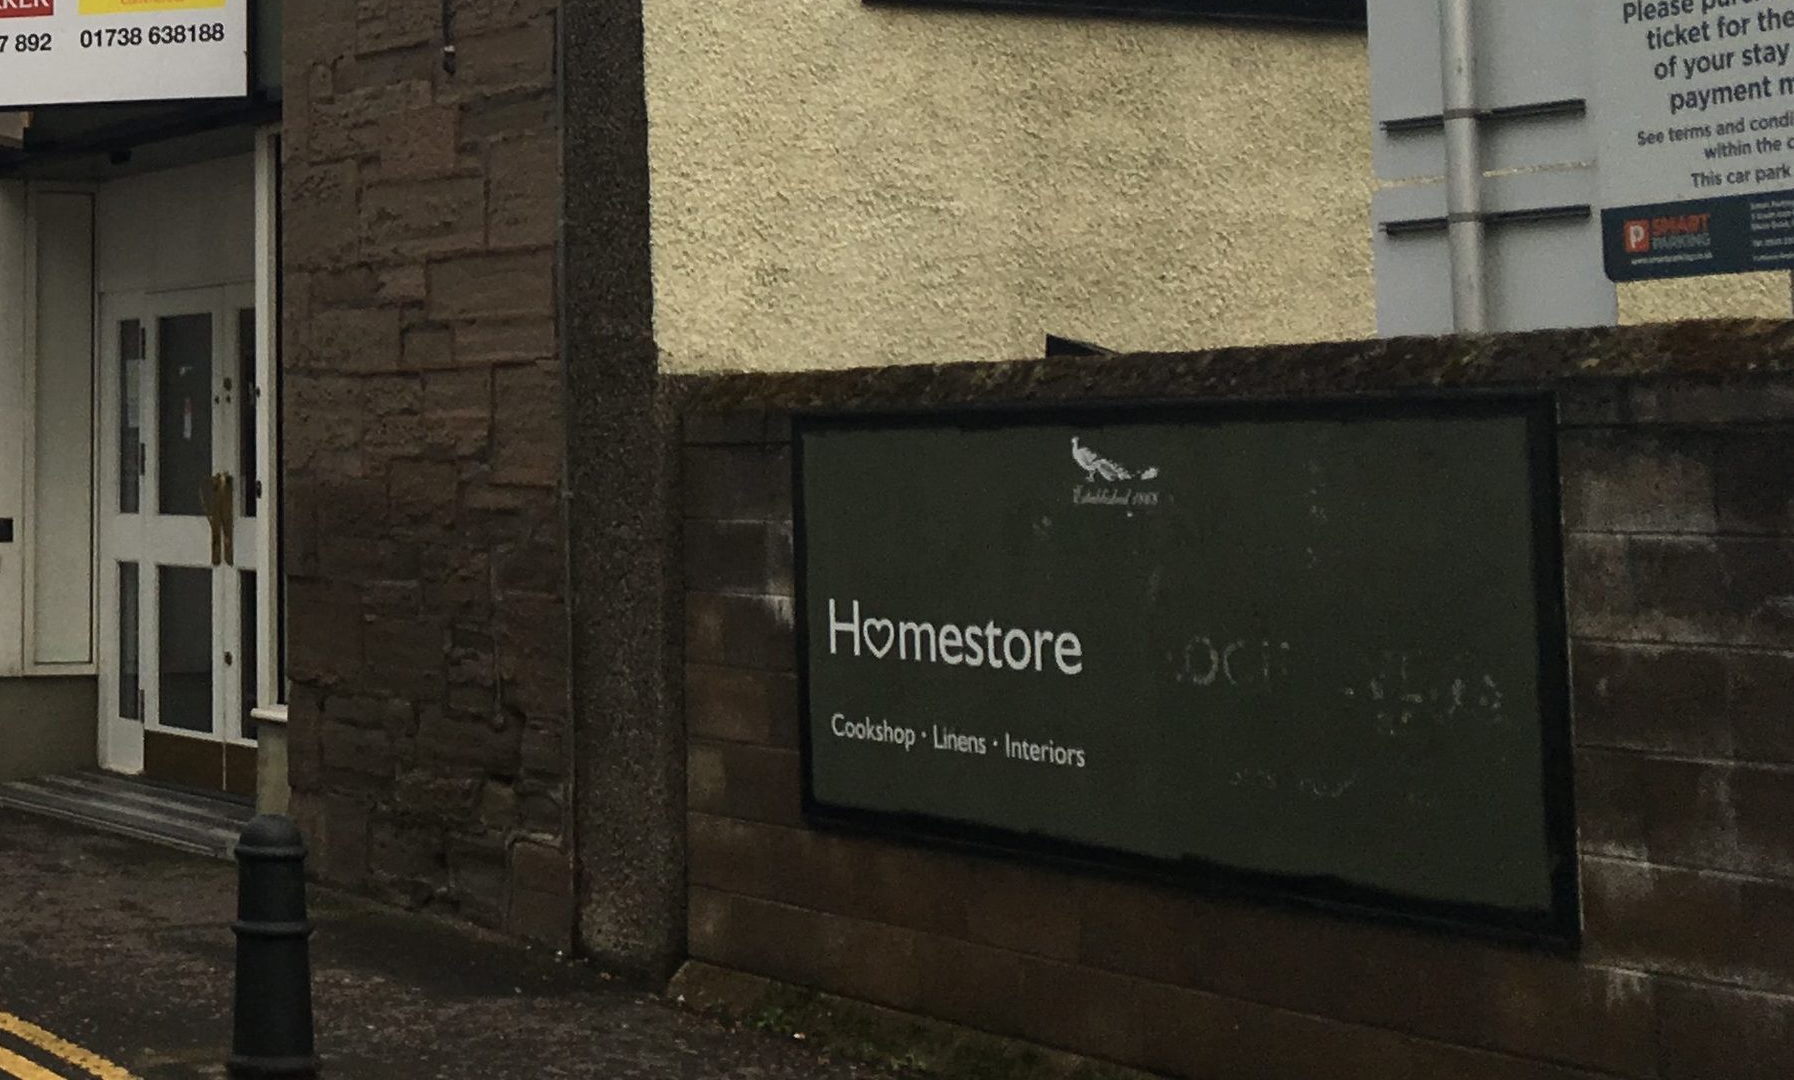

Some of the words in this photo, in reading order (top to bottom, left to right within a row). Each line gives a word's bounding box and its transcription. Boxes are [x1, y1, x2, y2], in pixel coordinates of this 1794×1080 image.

[15, 33, 52, 52] 892
[80, 26, 143, 48] 01738
[148, 23, 225, 45] 638188
[1647, 23, 1710, 51] ticket
[1717, 16, 1750, 39] for
[1757, 7, 1794, 32] the
[1654, 55, 1679, 80] of
[1683, 51, 1735, 79] your
[1742, 41, 1791, 68] stay
[1670, 75, 1773, 115] payment
[1637, 130, 1665, 147] See
[1669, 123, 1711, 143] terms
[1717, 116, 1746, 137] and
[1704, 139, 1752, 161] within
[1756, 136, 1781, 154] the
[1691, 169, 1723, 189] This
[1727, 168, 1752, 185] car
[1756, 164, 1792, 184] park
[831, 713, 916, 751] Cookshop
[933, 724, 986, 754] Linens
[1006, 732, 1086, 768] Interiors
